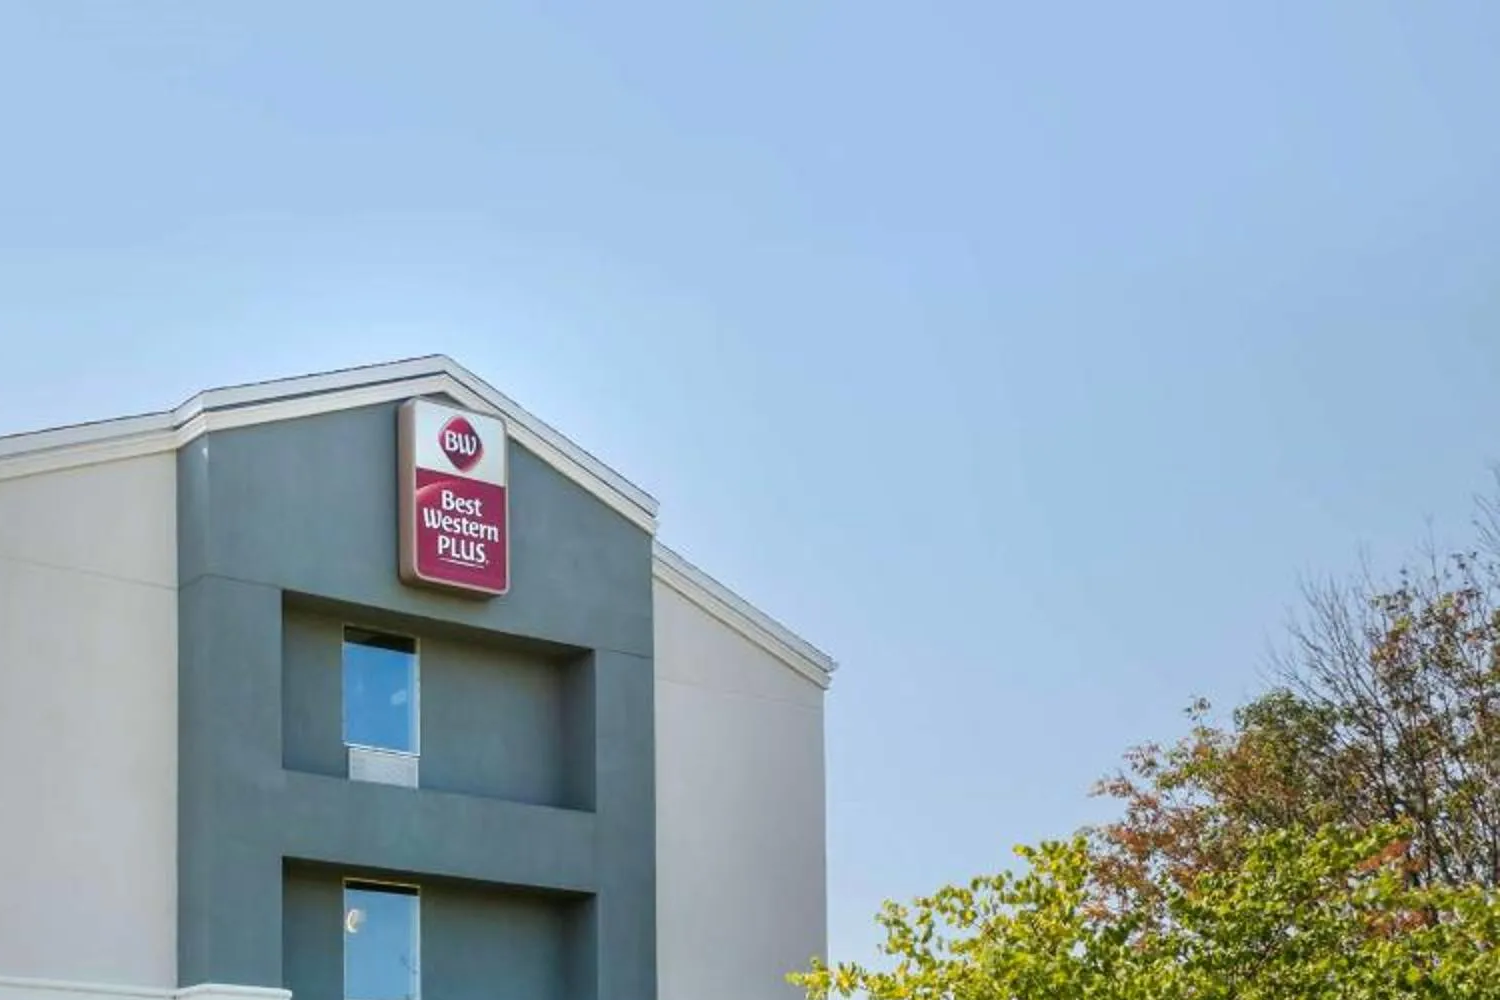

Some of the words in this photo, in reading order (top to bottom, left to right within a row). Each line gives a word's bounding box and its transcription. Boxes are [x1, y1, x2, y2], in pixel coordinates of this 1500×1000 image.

[445, 430, 477, 456] BW
[441, 490, 483, 517] Best
[423, 508, 499, 542] Western
[437, 535, 486, 563] PLUS
